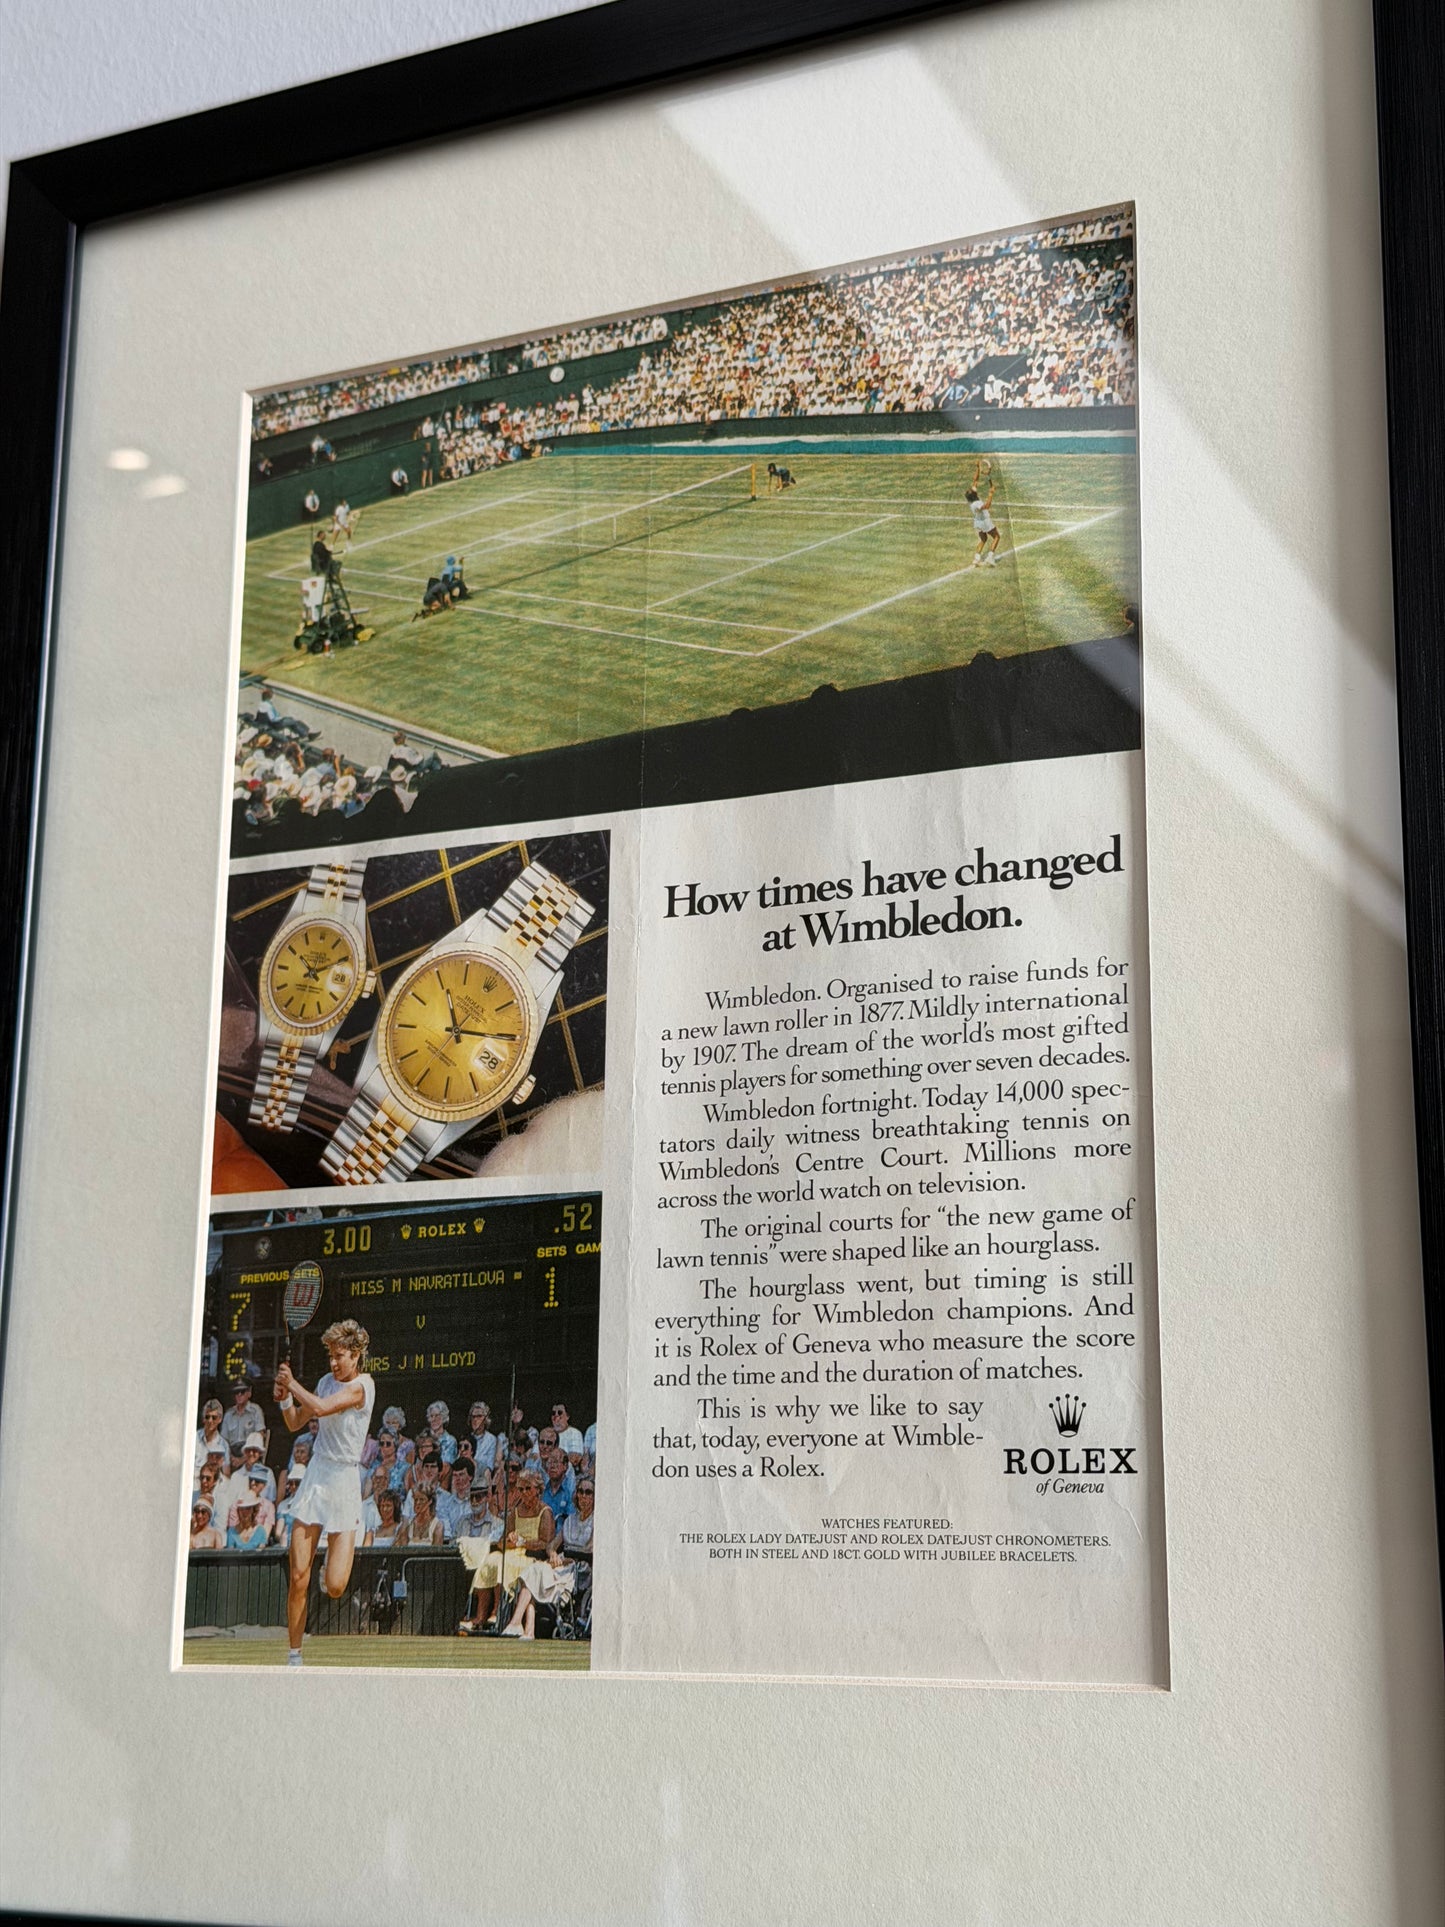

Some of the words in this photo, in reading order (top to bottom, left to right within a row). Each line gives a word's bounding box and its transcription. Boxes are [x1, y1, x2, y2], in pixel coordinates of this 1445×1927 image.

[663, 883, 750, 918] How
[757, 876, 853, 909] times
[862, 860, 946, 897] have
[955, 834, 1124, 890] changed
[762, 923, 796, 952] at
[799, 894, 1022, 947] Wimbledon.
[705, 982, 821, 1010] Wimbledon.
[827, 969, 933, 1002] Organised
[941, 974, 961, 988] to
[969, 964, 1018, 986] raise
[1027, 958, 1088, 982] funds
[1097, 956, 1128, 977] for
[662, 1030, 673, 1041] a
[678, 1026, 718, 1040] new
[724, 1016, 769, 1036] lawn
[776, 1008, 828, 1031] roller
[834, 1006, 852, 1026] in
[860, 1001, 904, 1023] 1877.
[908, 994, 980, 1022] Mildly
[986, 983, 1128, 1013] international
[662, 1048, 685, 1074] by
[694, 1044, 736, 1065] 1907.
[742, 1040, 778, 1061] The
[786, 1037, 848, 1057] dream
[856, 1030, 878, 1052] of
[882, 1028, 914, 1049] the
[1002, 1023, 1055, 1040] most
[1062, 1012, 1128, 1043] gifted
[479, 1051, 499, 1070] 28
[661, 1073, 716, 1095] tennis
[720, 1070, 786, 1097] players
[791, 1064, 818, 1085] for
[822, 1057, 923, 1082] something
[927, 1060, 972, 1074] over
[976, 1056, 1032, 1071] seven
[1039, 1042, 1130, 1067] decades.
[702, 1096, 815, 1123] Wimbledon
[822, 1089, 917, 1117] fortnight.
[922, 1084, 988, 1111] Today
[996, 1079, 1063, 1104] 14,000
[1072, 1084, 1129, 1105] spec-
[660, 1138, 715, 1154] tators
[726, 1126, 775, 1154] daily
[785, 1124, 860, 1145] witness
[872, 1113, 1010, 1140] breathtaking
[1022, 1108, 1089, 1130] tennis
[1102, 1114, 1130, 1129] on
[796, 1153, 864, 1173] Centre
[881, 1147, 948, 1168] Court.
[963, 1140, 1056, 1162] Millions
[1074, 1143, 1131, 1158] more
[658, 1195, 717, 1209] across
[723, 1184, 752, 1205] the
[757, 1179, 814, 1203] world
[820, 1176, 881, 1200] watch
[887, 1183, 912, 1196] on
[918, 1171, 1025, 1194] television.
[418, 1223, 467, 1238] ROLEX
[554, 1202, 593, 1232] .52
[700, 1217, 738, 1238] The
[745, 1212, 822, 1242] original
[829, 1215, 893, 1232] courts
[901, 1207, 930, 1228] for
[988, 1211, 1034, 1224] new
[1042, 1208, 1102, 1230] game
[1111, 1198, 1136, 1220] of
[323, 1225, 372, 1255] 3.00
[537, 1245, 567, 1258] SETS
[657, 1248, 704, 1268] lawn
[779, 1250, 827, 1263] were
[832, 1236, 906, 1266] shaped
[912, 1235, 948, 1257] like
[954, 1243, 980, 1256] an
[987, 1230, 1099, 1260] hourglass.
[240, 1270, 290, 1285] PREVIOUS
[293, 1267, 320, 1280] SETS
[351, 1279, 385, 1296] MISS
[392, 1278, 402, 1292] M
[409, 1269, 504, 1291] NAVRATILOVA
[544, 1266, 559, 1308] 1
[700, 1278, 736, 1299] The
[750, 1274, 844, 1302] hourglass
[856, 1276, 913, 1294] went,
[925, 1269, 960, 1291] but
[974, 1267, 1047, 1294] timing
[1061, 1266, 1078, 1286] is
[1092, 1262, 1133, 1286] still
[230, 1292, 250, 1331] 7
[416, 1315, 426, 1329] V
[655, 1306, 760, 1335] everything
[772, 1304, 801, 1325] for
[812, 1299, 934, 1324] Wimbledon
[948, 1297, 1072, 1325] champions.
[1084, 1293, 1134, 1316] And
[655, 1338, 669, 1358] it
[677, 1337, 691, 1357] is
[700, 1334, 757, 1356] Rolex
[765, 1333, 787, 1354] of
[793, 1333, 872, 1354] Geneva
[878, 1329, 924, 1352] who
[933, 1336, 1023, 1350] measure
[1032, 1326, 1067, 1348] the
[1076, 1333, 1135, 1347] score
[225, 1341, 246, 1380] 6
[363, 1356, 390, 1373] MRS
[398, 1354, 407, 1370] J
[415, 1354, 424, 1369] M
[431, 1351, 476, 1369] LLOYD
[654, 1364, 690, 1386] and
[697, 1364, 726, 1386] the
[732, 1364, 775, 1384] time
[781, 1361, 819, 1384] and
[825, 1361, 857, 1382] the
[863, 1360, 953, 1382] duration
[960, 1357, 982, 1380] of
[986, 1356, 1082, 1379] matches.
[697, 1397, 740, 1418] This
[751, 1398, 766, 1418] is
[776, 1395, 820, 1424] why
[829, 1404, 858, 1416] we
[870, 1394, 906, 1416] like
[917, 1400, 937, 1415] to
[948, 1402, 984, 1422] say
[653, 1427, 696, 1450] that,
[702, 1426, 760, 1454] today,
[767, 1434, 858, 1454] everyone
[865, 1431, 885, 1446] at
[892, 1423, 983, 1446] Wimble-
[652, 1456, 689, 1478] don
[696, 1465, 736, 1478] uses
[742, 1465, 754, 1477] a
[760, 1455, 824, 1477] Rolex.
[1003, 1448, 1138, 1474] ROLEX
[1036, 1478, 1051, 1496] of
[1053, 1478, 1104, 1493] Geneva
[822, 1519, 880, 1528] WATCHES
[884, 1519, 952, 1529] FEATURED:
[680, 1534, 703, 1543] THE
[707, 1534, 746, 1543] ROLEX
[750, 1534, 782, 1543] LADY
[786, 1534, 847, 1544] DATEJUST
[850, 1534, 877, 1544] AND
[882, 1534, 924, 1544] ROLEX
[928, 1535, 992, 1545] DATEJUST
[996, 1535, 1110, 1546] CHRONOMETERS.
[710, 1548, 741, 1558] BOTH
[746, 1549, 758, 1558] IN
[762, 1549, 798, 1558] STEEL
[802, 1549, 828, 1559] AND
[834, 1549, 860, 1559] 18CT.
[864, 1550, 900, 1560] GOLD
[904, 1550, 937, 1560] WITH
[941, 1550, 996, 1560] JUBILEE
[1000, 1551, 1077, 1562] BRACELETS.
